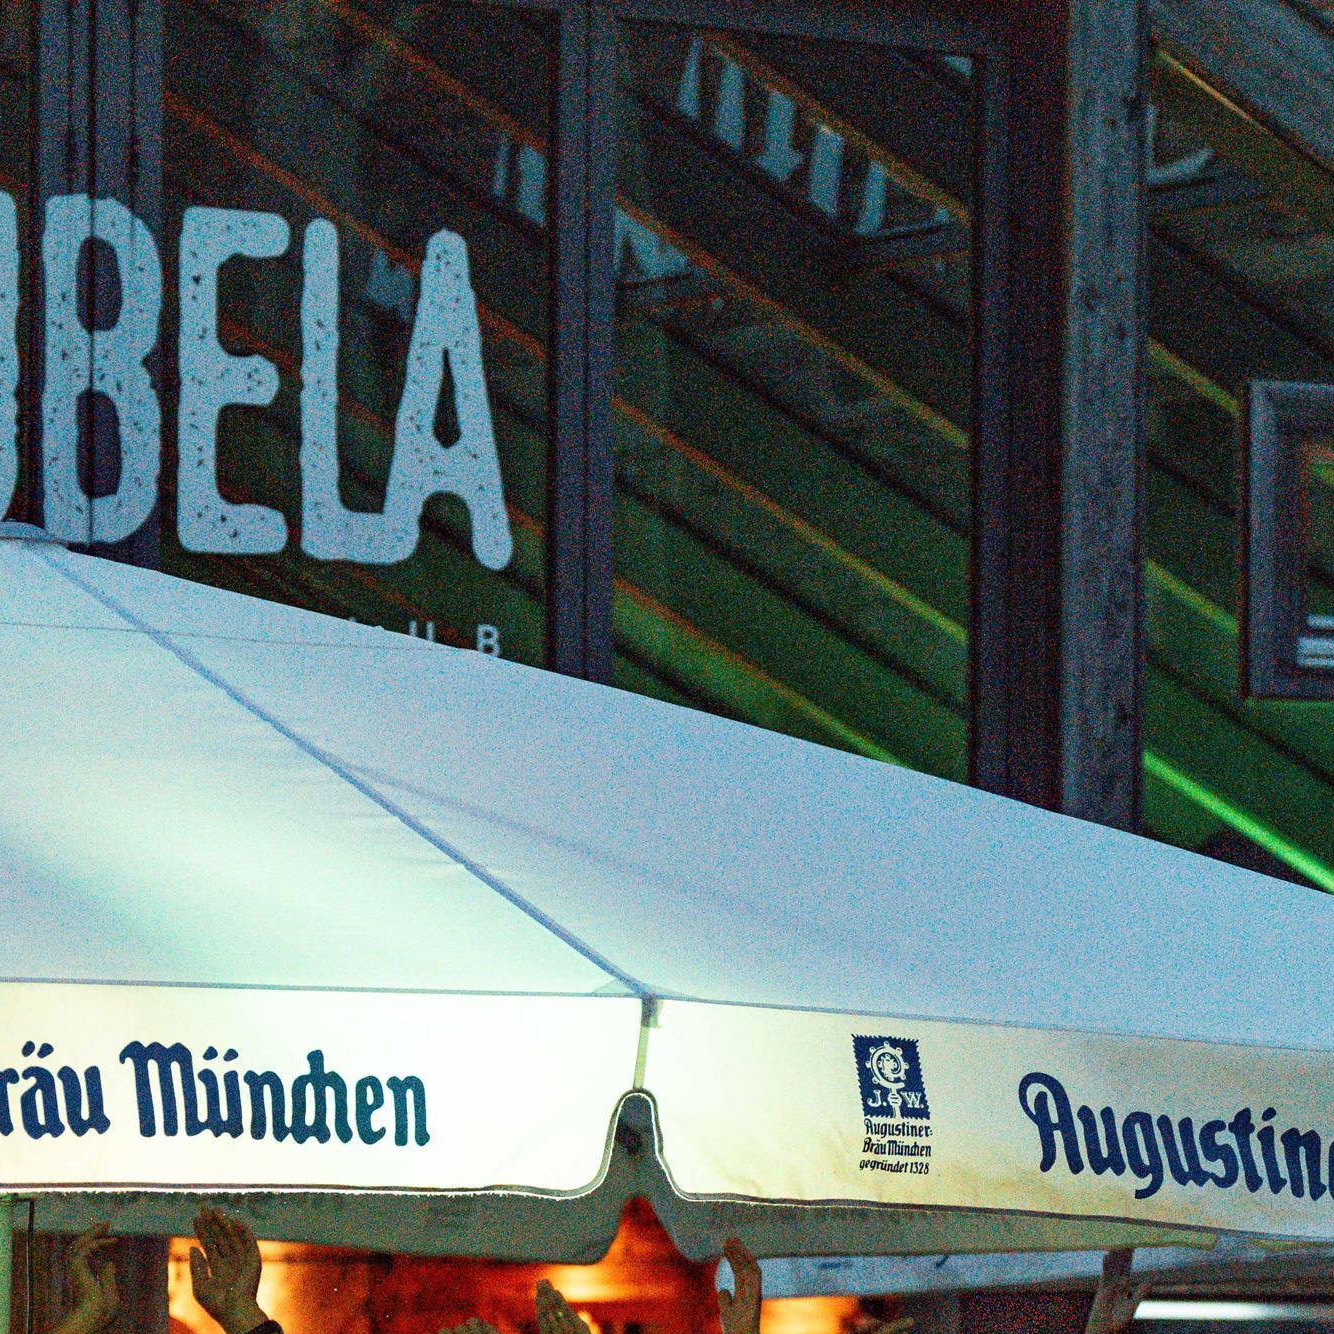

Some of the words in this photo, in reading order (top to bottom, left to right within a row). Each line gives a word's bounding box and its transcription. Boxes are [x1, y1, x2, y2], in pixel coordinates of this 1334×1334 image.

[119, 1040, 430, 1147] München
[861, 1137, 886, 1155] Bräu
[886, 1139, 932, 1158] München
[859, 1159, 908, 1174] gegründet
[909, 1161, 930, 1175] 1328
